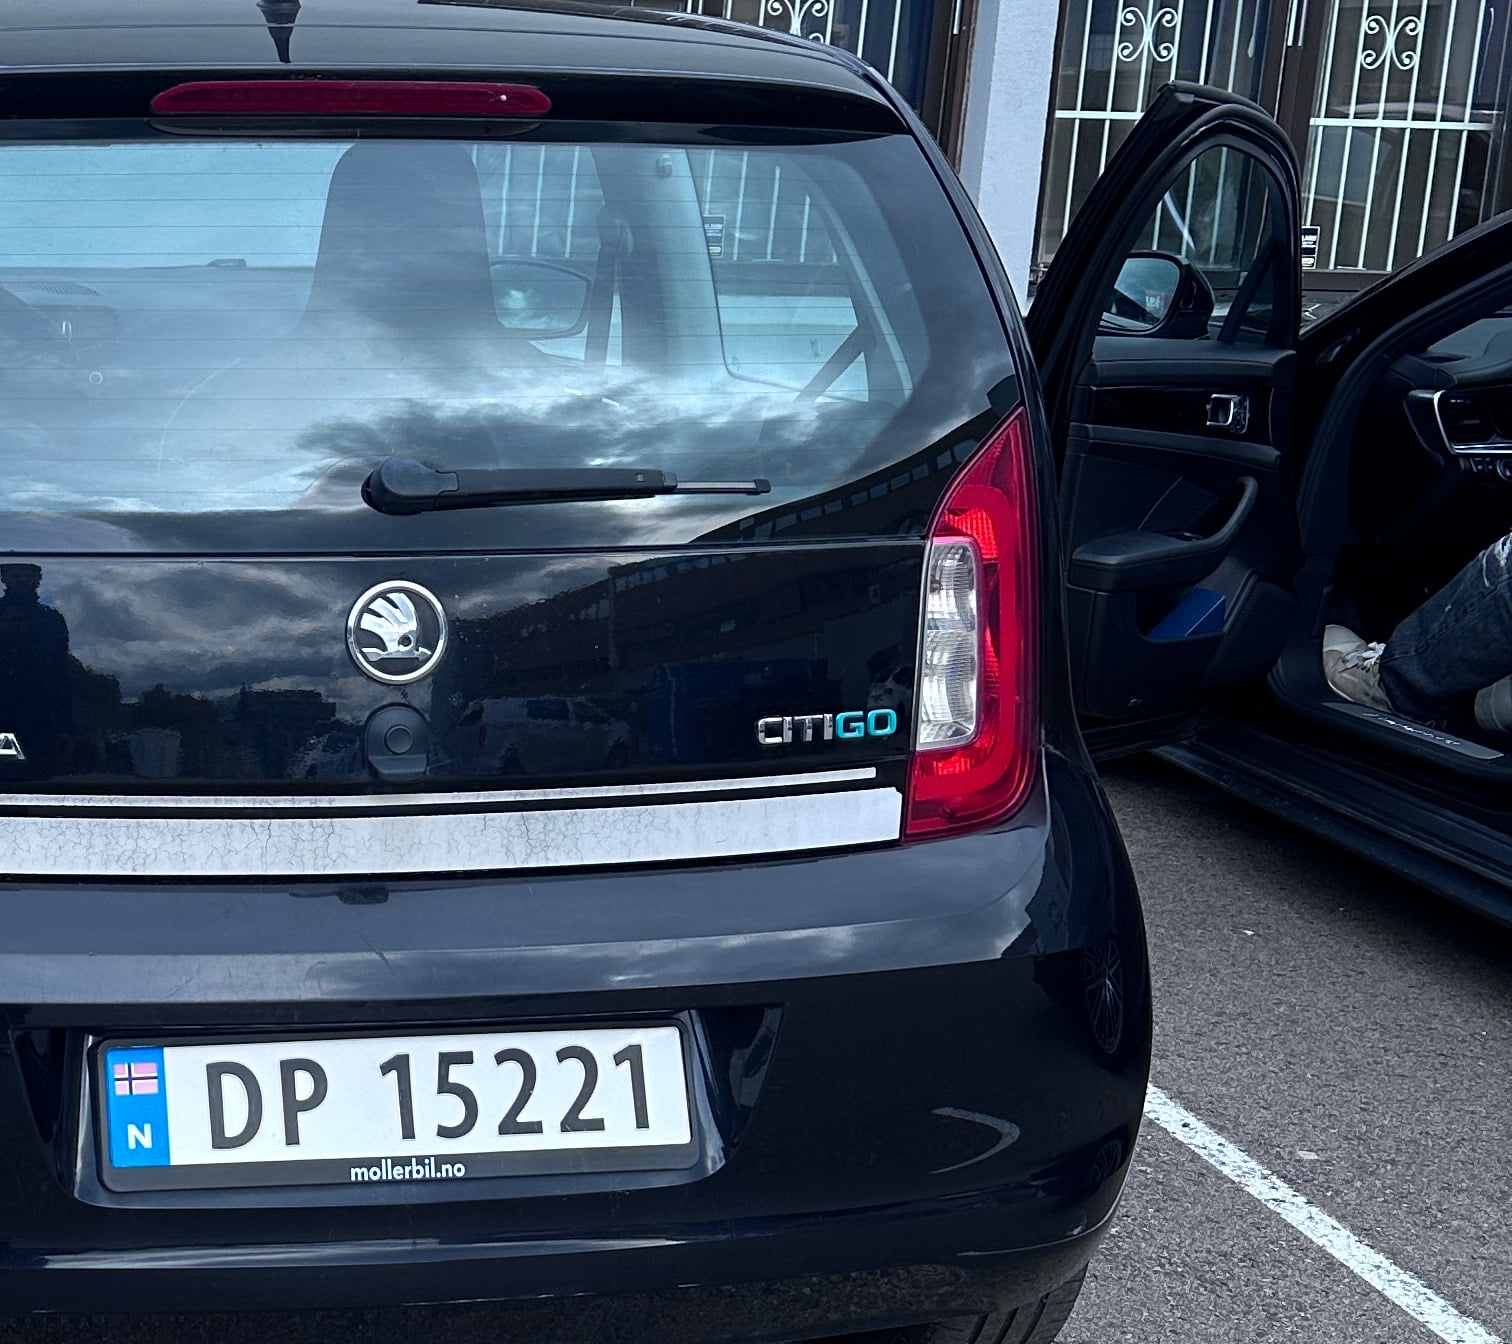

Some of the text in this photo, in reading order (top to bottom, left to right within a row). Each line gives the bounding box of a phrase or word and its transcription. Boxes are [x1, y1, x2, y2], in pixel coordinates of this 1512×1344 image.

[757, 708, 898, 745] CITIGO
[205, 1044, 651, 1150] DP 15221
[127, 1124, 153, 1150] N
[350, 1156, 466, 1182] mollerbil.no
